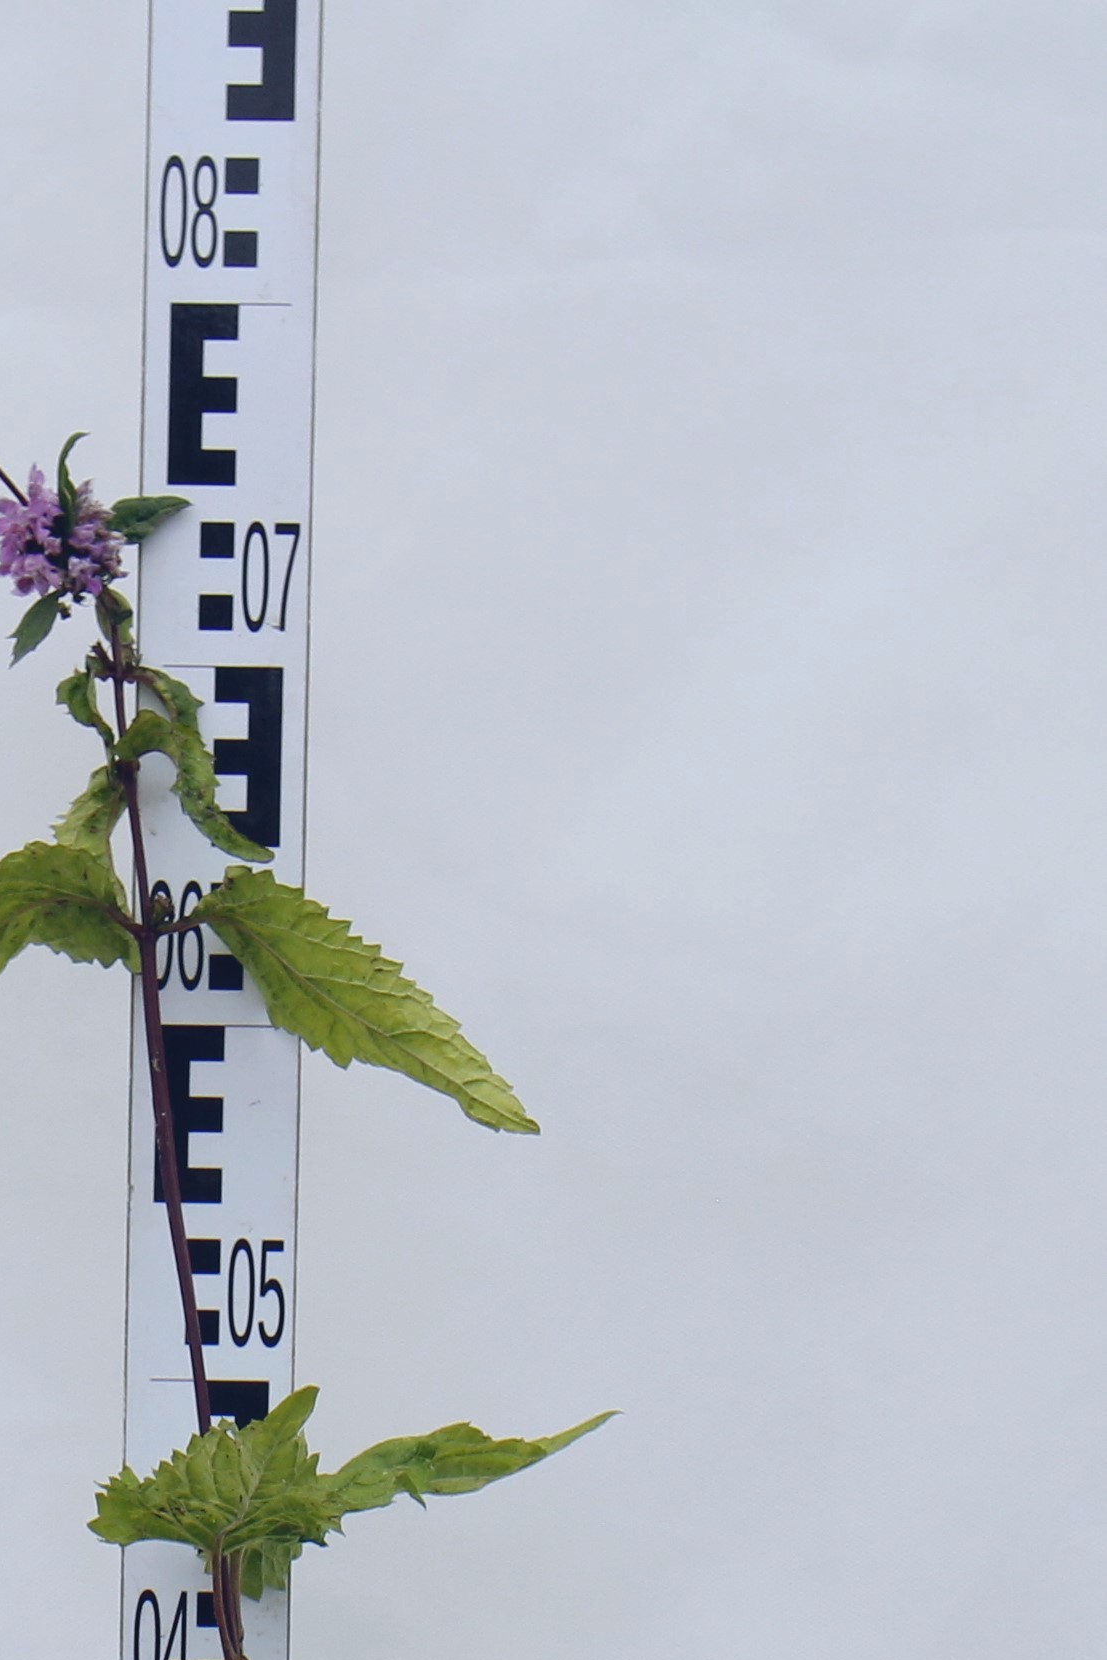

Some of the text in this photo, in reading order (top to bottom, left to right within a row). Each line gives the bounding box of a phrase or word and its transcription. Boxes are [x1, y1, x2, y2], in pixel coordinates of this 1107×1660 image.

[160, 155, 218, 267] 08
[242, 521, 300, 632] 07
[227, 1238, 285, 1347] 05
